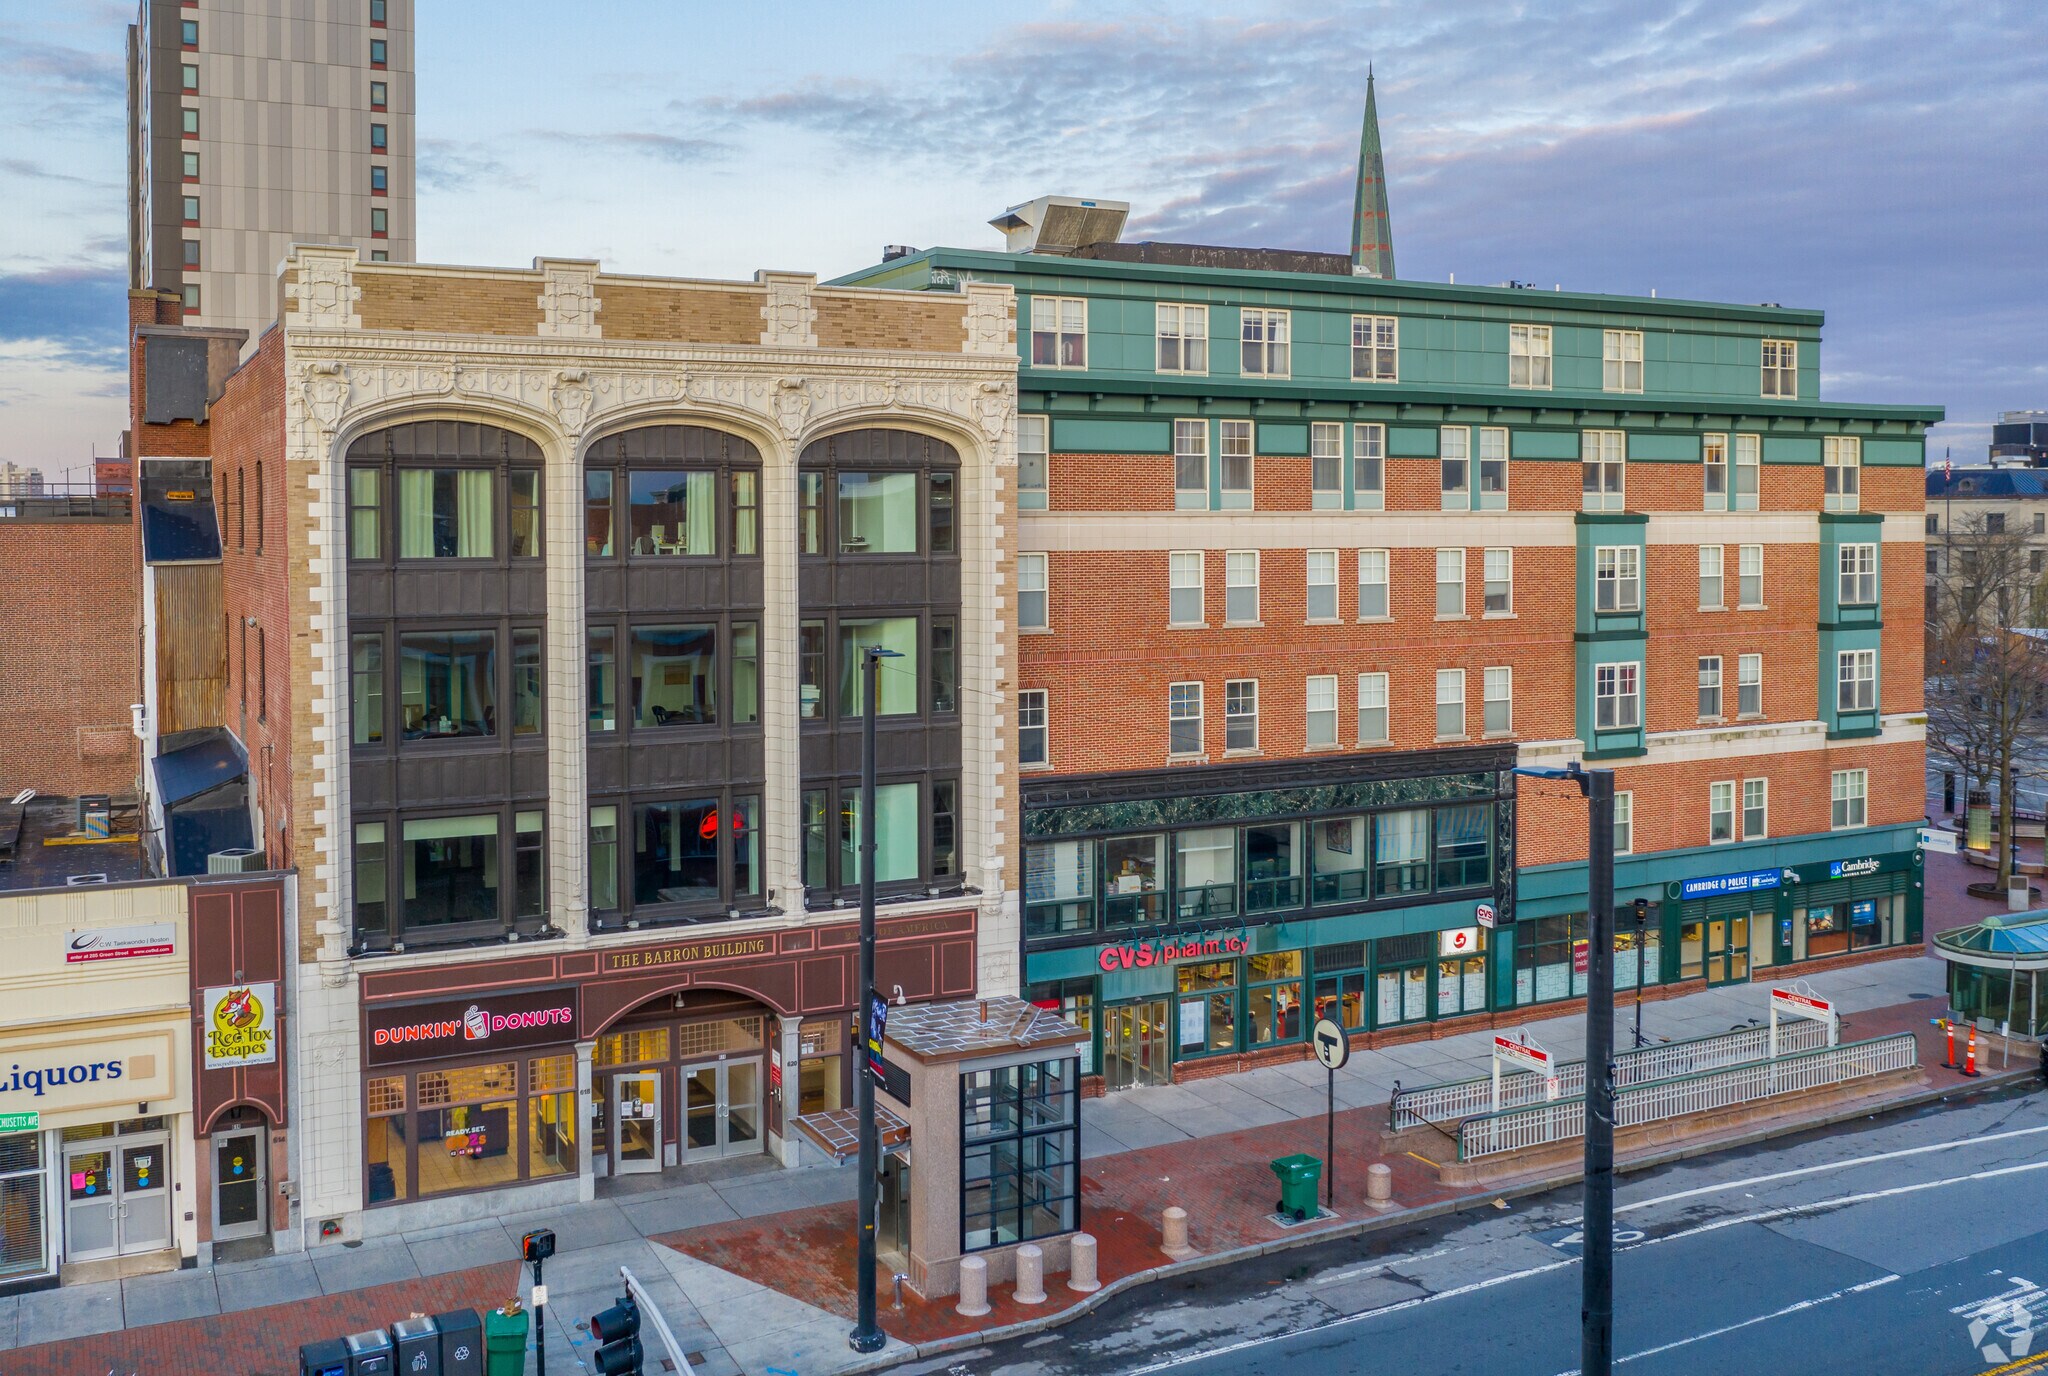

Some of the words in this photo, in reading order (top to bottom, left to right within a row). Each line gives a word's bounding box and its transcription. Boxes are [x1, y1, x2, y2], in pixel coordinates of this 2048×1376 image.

[1841, 858, 1880, 872] Cambridge
[1686, 880, 1719, 893] CAMBRIDGE
[1728, 876, 1748, 887] POLICE
[1478, 908, 1493, 920] CVS
[149, 936, 170, 944] Boston
[612, 954, 640, 968] THE
[644, 946, 699, 965] BARRON
[703, 939, 764, 958] BUILDING
[1787, 994, 1813, 1006] CENTRAL
[244, 1026, 272, 1042] Fox
[374, 1020, 462, 1046] DUNKIN'
[492, 1007, 572, 1032] DONUTS
[207, 1043, 266, 1059] Escapes
[1318, 1031, 1337, 1062] T
[1508, 1043, 1532, 1056] CENTRAL
[27, 1115, 38, 1126] AVE
